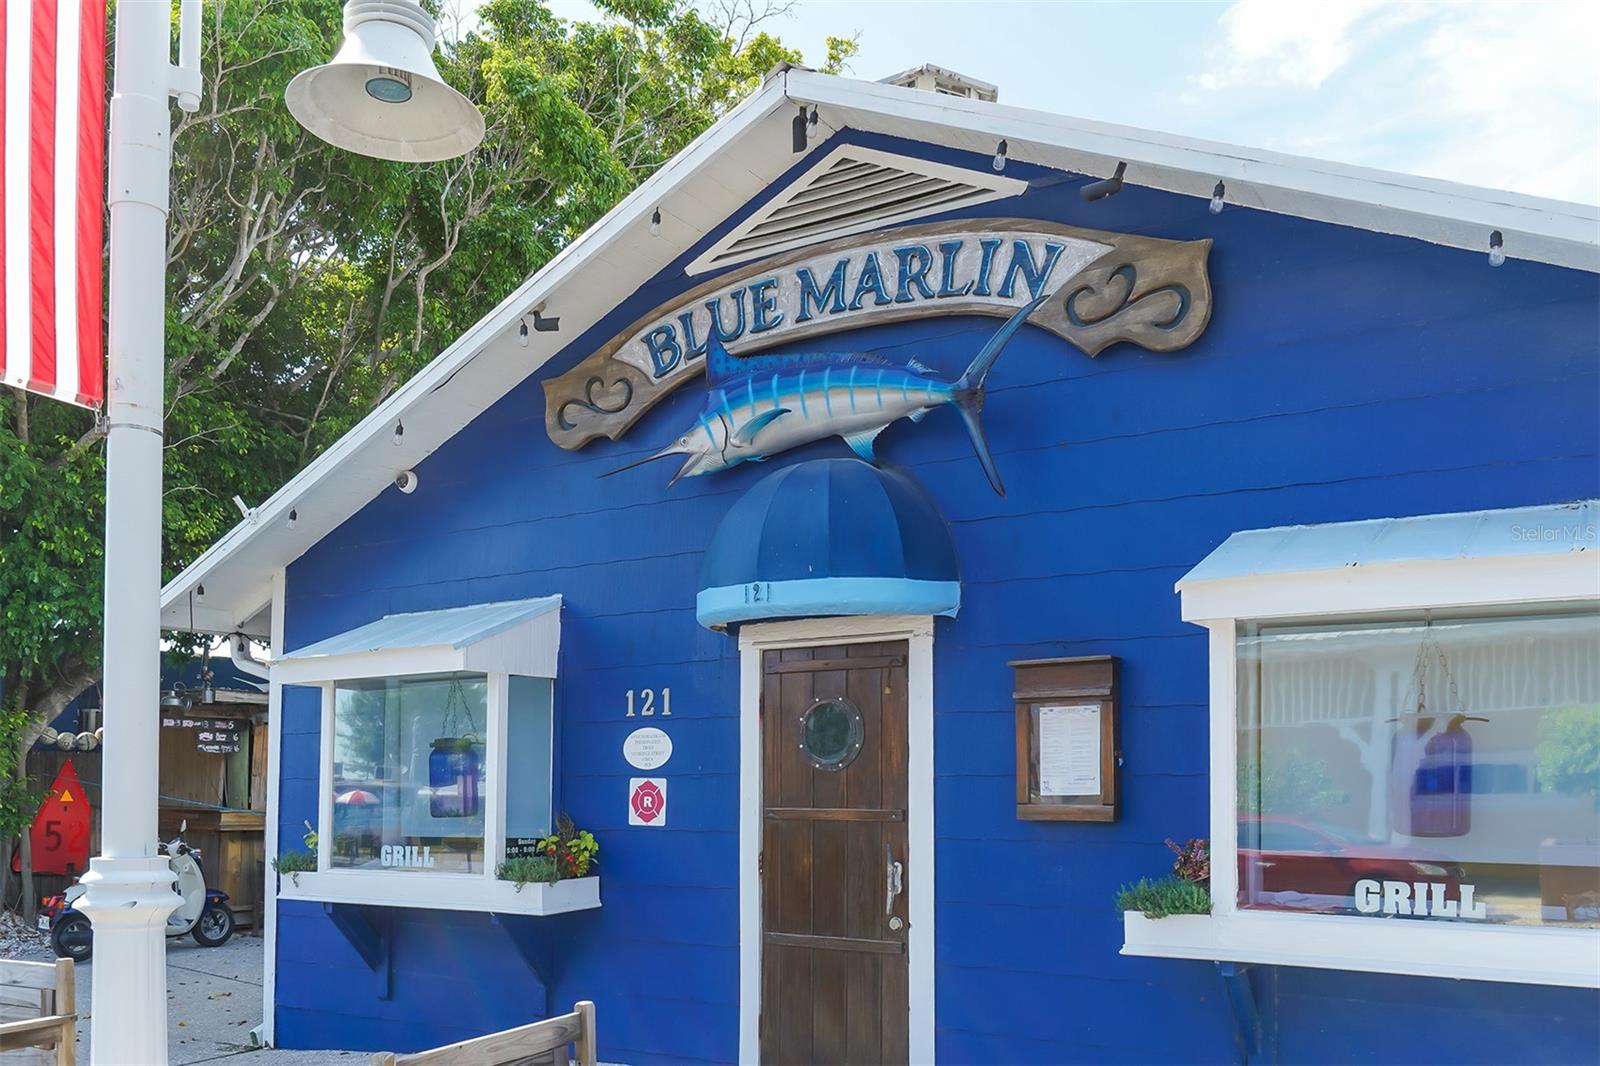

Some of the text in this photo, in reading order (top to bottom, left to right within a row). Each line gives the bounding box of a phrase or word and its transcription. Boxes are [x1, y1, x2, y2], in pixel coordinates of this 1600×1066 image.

[640, 238, 1066, 379] BLUE MARLIN
[744, 583, 770, 604] 121
[625, 687, 672, 717] 121
[643, 796, 653, 808] R
[380, 844, 434, 868] GRILL
[1354, 879, 1486, 919] GRILL
